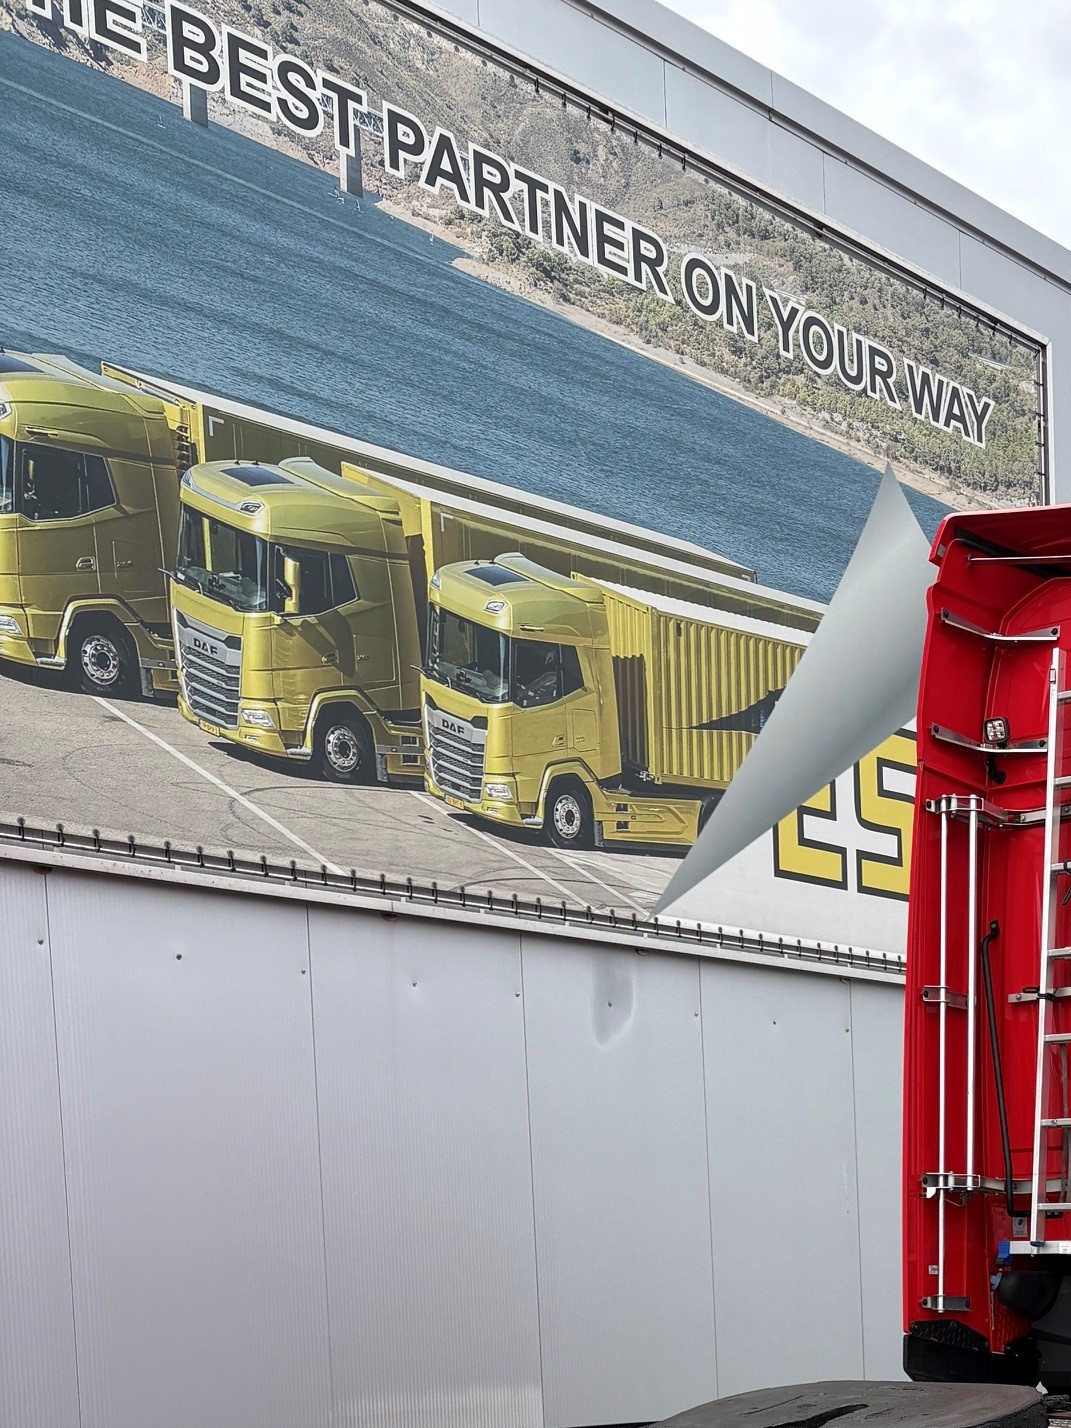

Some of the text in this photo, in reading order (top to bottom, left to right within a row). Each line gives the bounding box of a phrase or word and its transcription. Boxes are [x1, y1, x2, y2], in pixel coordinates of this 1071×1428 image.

[167, 4, 367, 155] BEST
[383, 100, 674, 303] PARTNER
[681, 252, 758, 342] ON
[762, 287, 901, 408] YOUR
[904, 357, 994, 448] WAY
[193, 637, 218, 655] DAF
[441, 718, 465, 734] DAF
